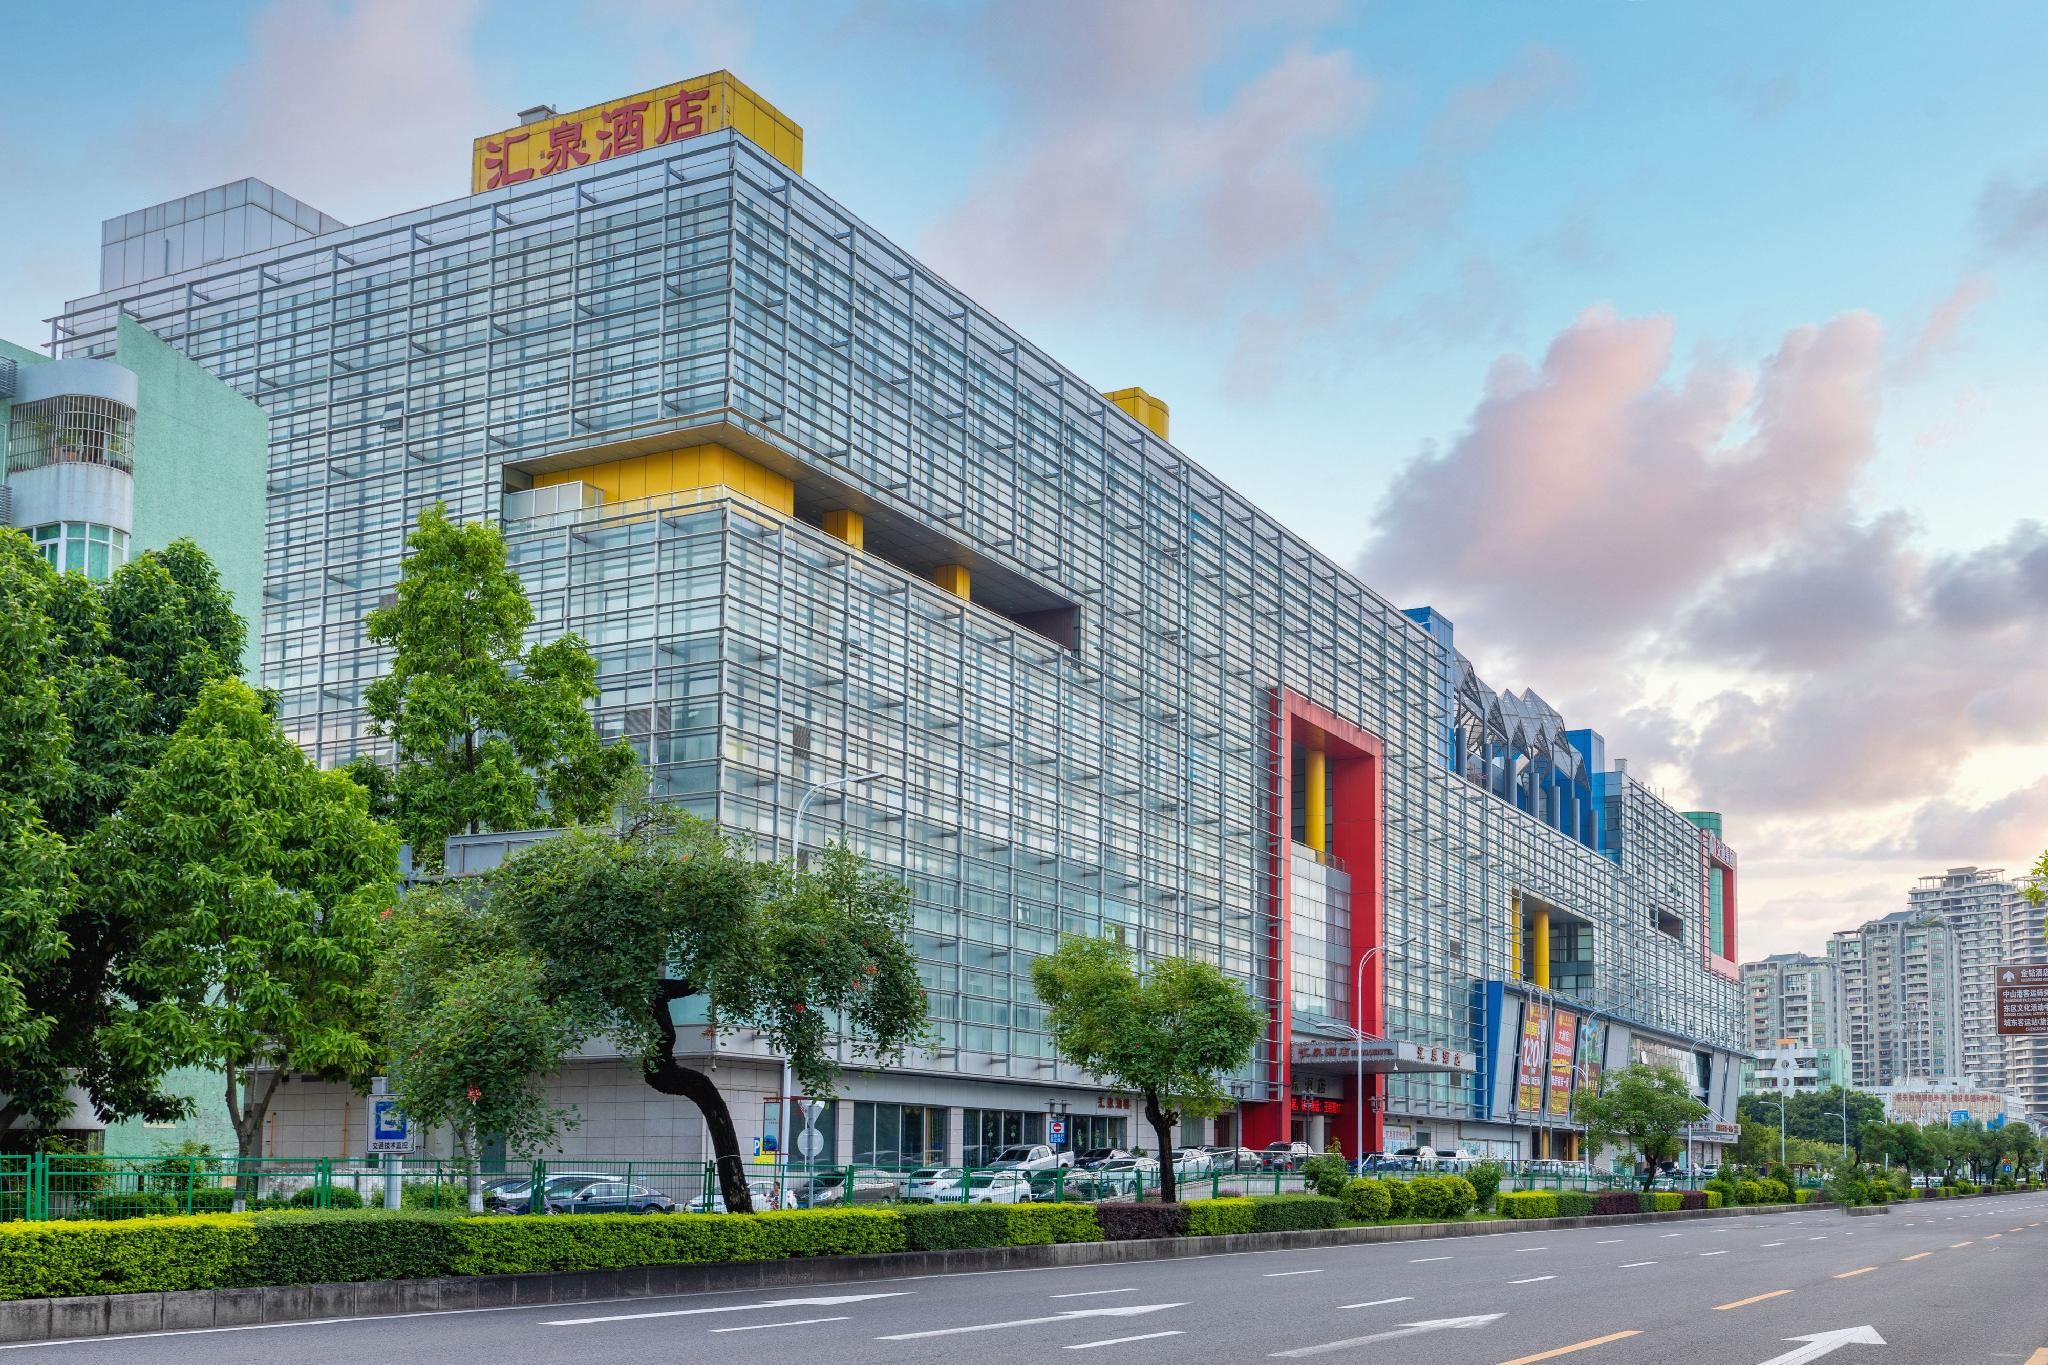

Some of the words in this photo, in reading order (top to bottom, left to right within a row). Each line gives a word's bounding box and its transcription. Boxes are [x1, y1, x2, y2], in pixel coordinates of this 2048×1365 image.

[485, 89, 710, 189] 汇泉酒店
[754, 1140, 760, 1154] P
